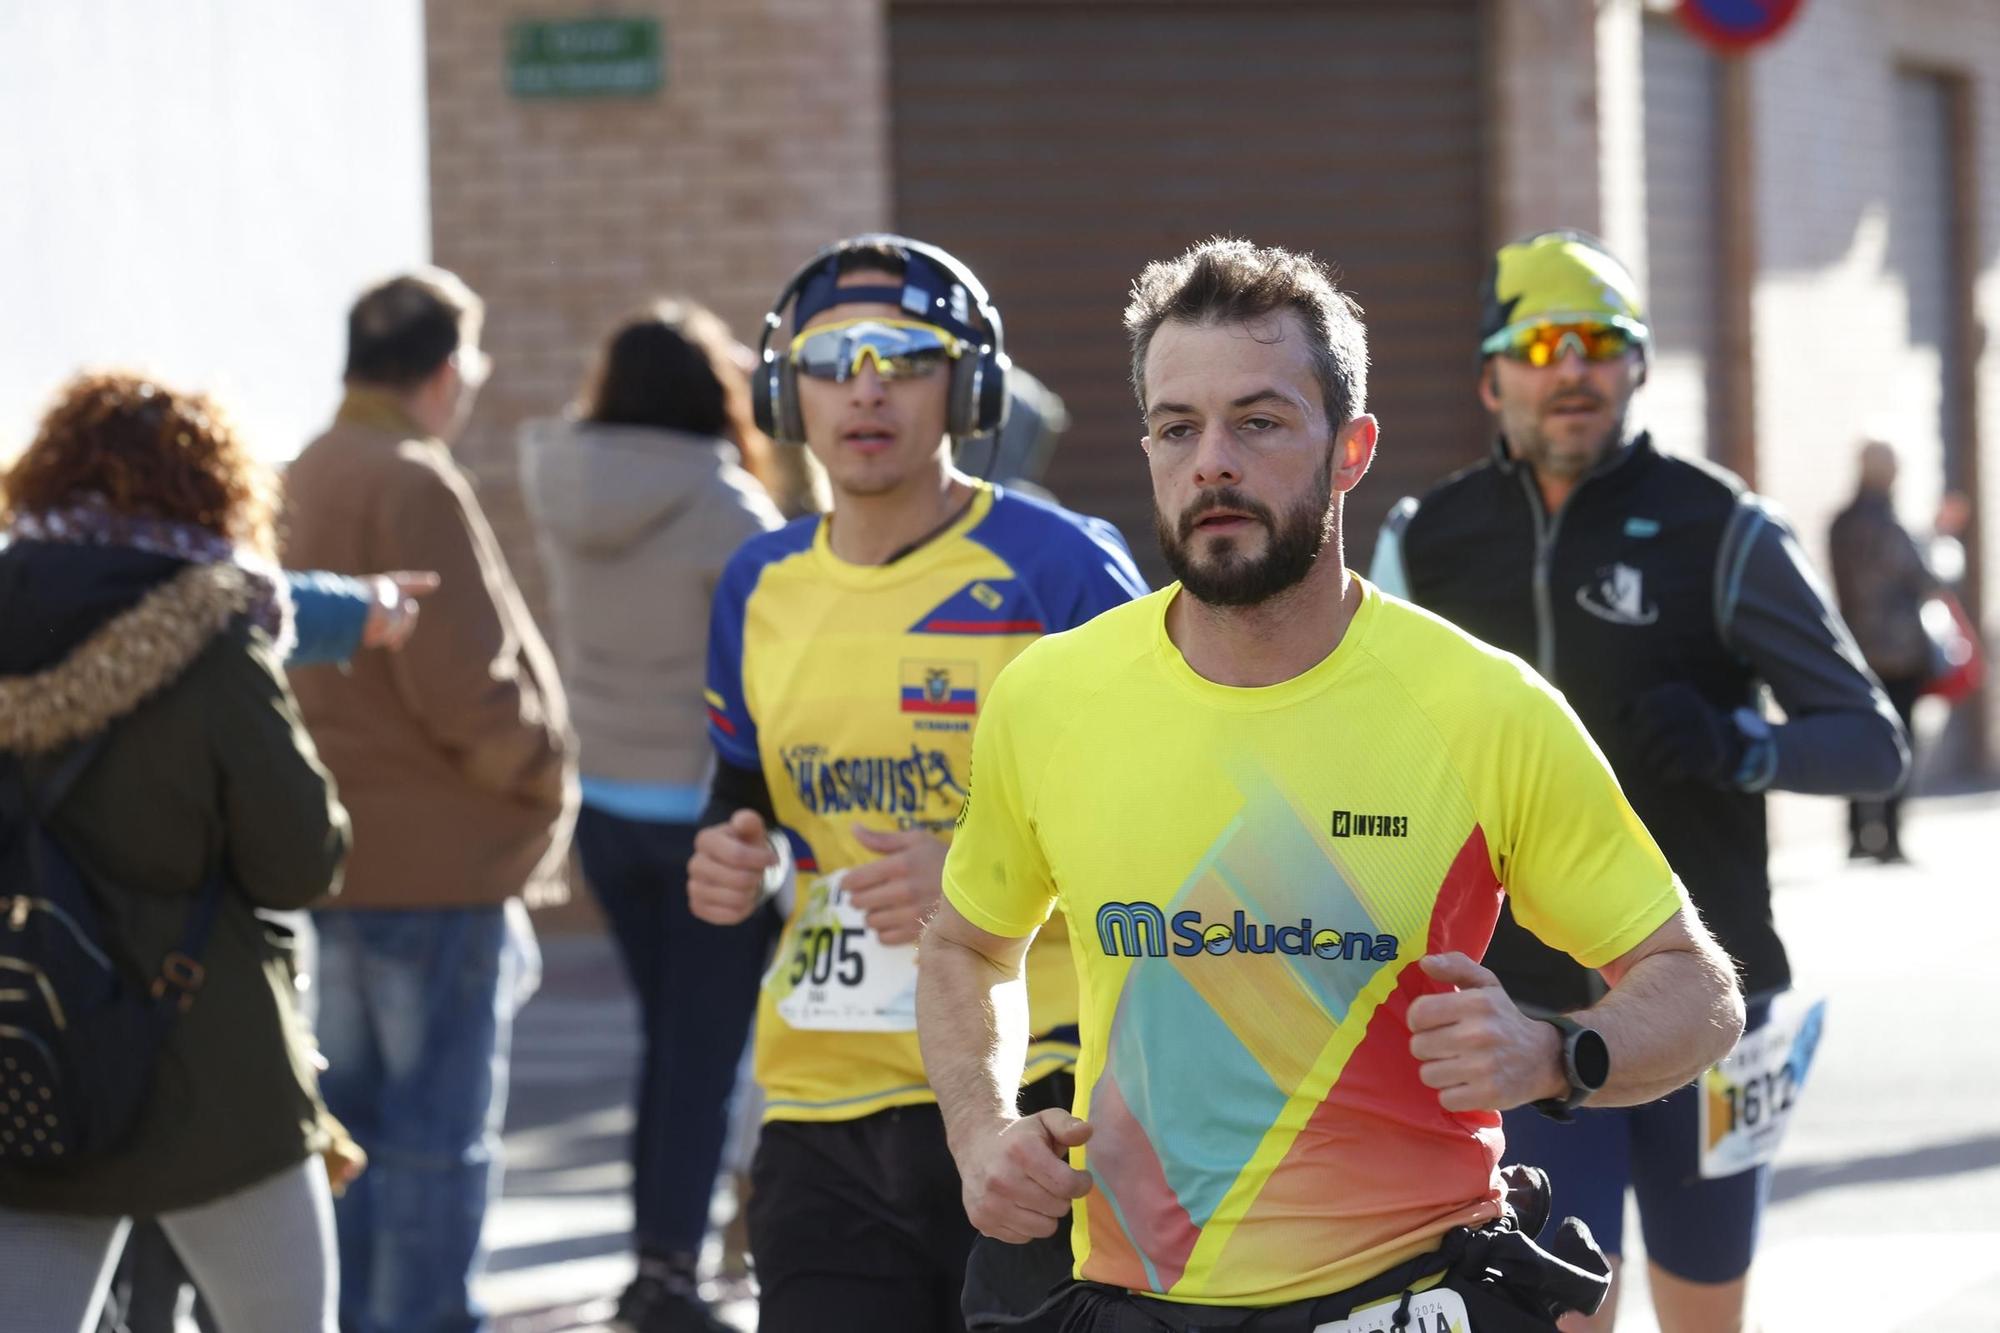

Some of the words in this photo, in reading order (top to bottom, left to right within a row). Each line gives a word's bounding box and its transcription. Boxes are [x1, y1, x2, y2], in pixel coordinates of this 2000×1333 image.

[1353, 814, 1408, 838] INVERSE
[1171, 910, 1400, 962] Soluciona
[1414, 1302, 1443, 1317] 2024
